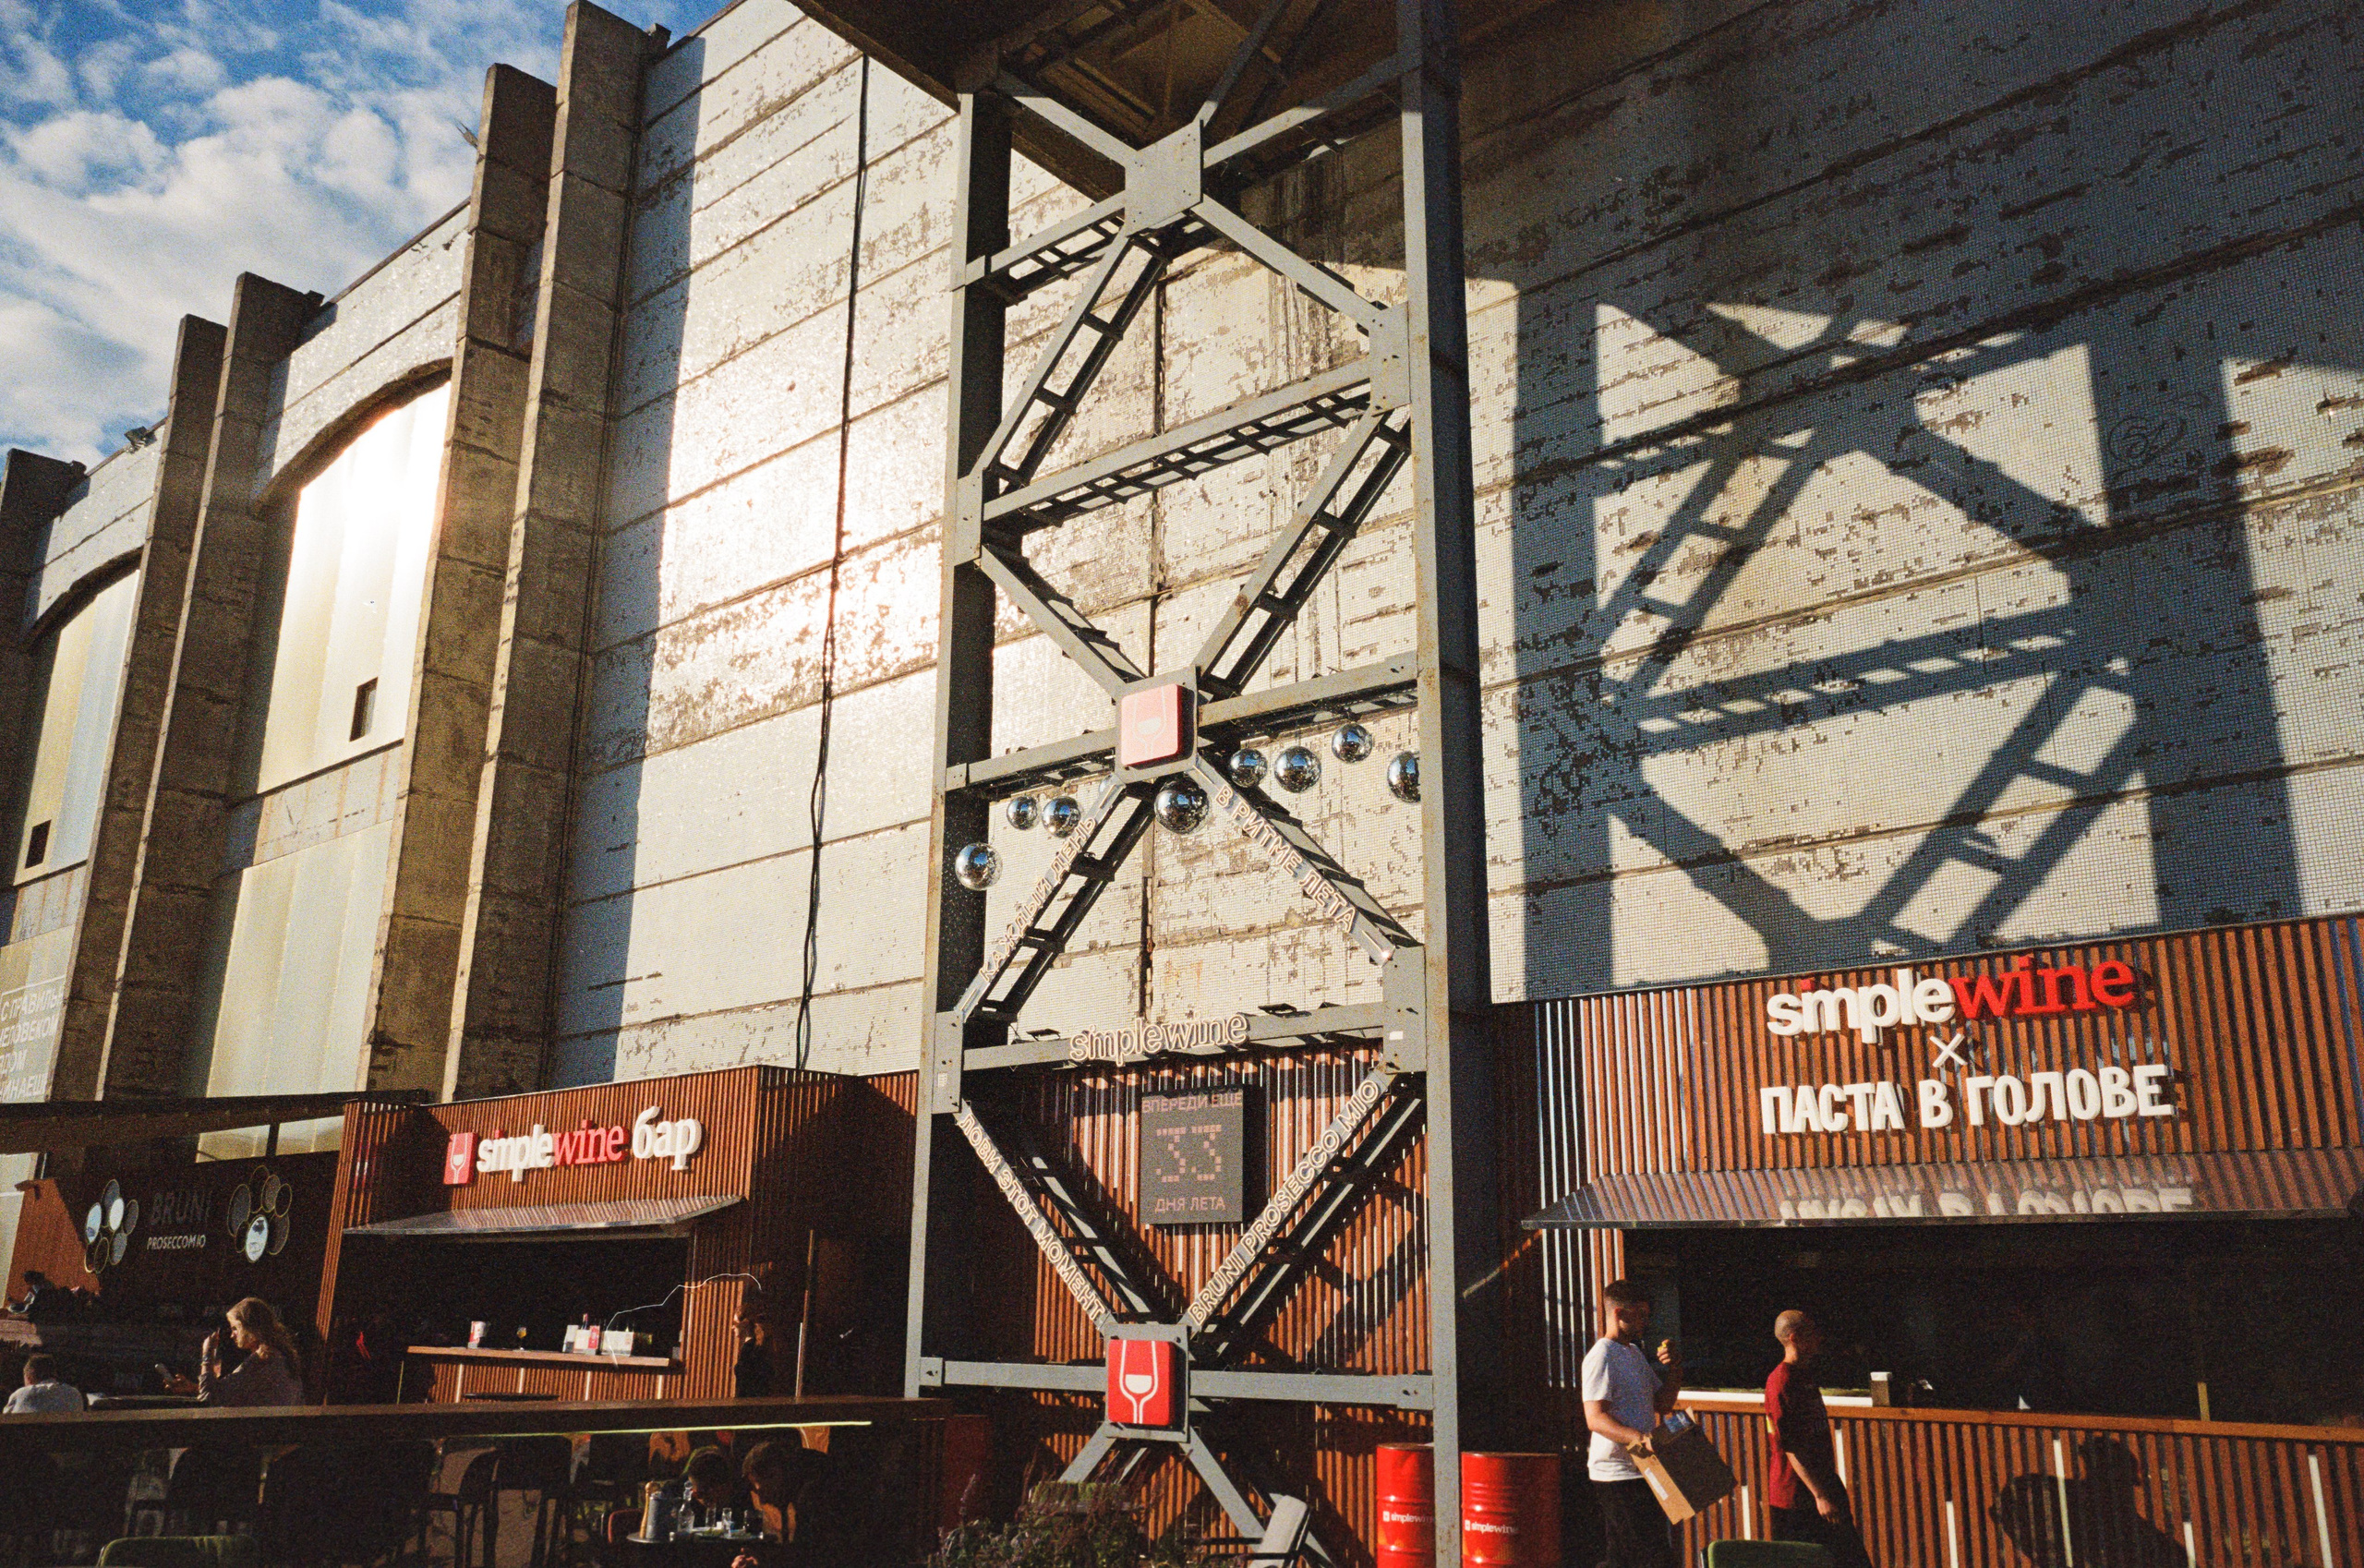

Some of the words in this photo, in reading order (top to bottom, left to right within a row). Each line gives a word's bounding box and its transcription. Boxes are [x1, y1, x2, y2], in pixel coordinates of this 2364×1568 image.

[1215, 785, 1234, 807] В
[1231, 801, 1302, 876] РИТМЕ
[1298, 868, 1356, 933] ЛЕТА
[979, 877, 1053, 981] КАЖДЫЙ
[1051, 817, 1096, 882] ДЕНЬ
[1767, 955, 2139, 1043] simplewine
[1069, 1010, 1248, 1067] simplewine
[1141, 1095, 1208, 1113] ВПЕРЕДИ
[1760, 1080, 1905, 1135] ПАСТА
[1918, 1080, 1953, 1128] В
[1966, 1064, 2174, 1126] ГОЛОВЕ
[476, 1119, 629, 1182] simplewine
[633, 1105, 702, 1170] бар
[1156, 1124, 1222, 1183] 33
[957, 1113, 1002, 1174] ЛОВИ
[997, 1168, 1039, 1225] ЭТОТ
[1033, 1223, 1105, 1321] МОМЕНТ
[1154, 1198, 1186, 1213] ДНЯ
[1189, 1196, 1226, 1212] ЛЕТА
[1188, 1251, 1246, 1325] BRUNI
[1240, 1130, 1340, 1257] PROSECCO
[1336, 1080, 1379, 1132] MIO
